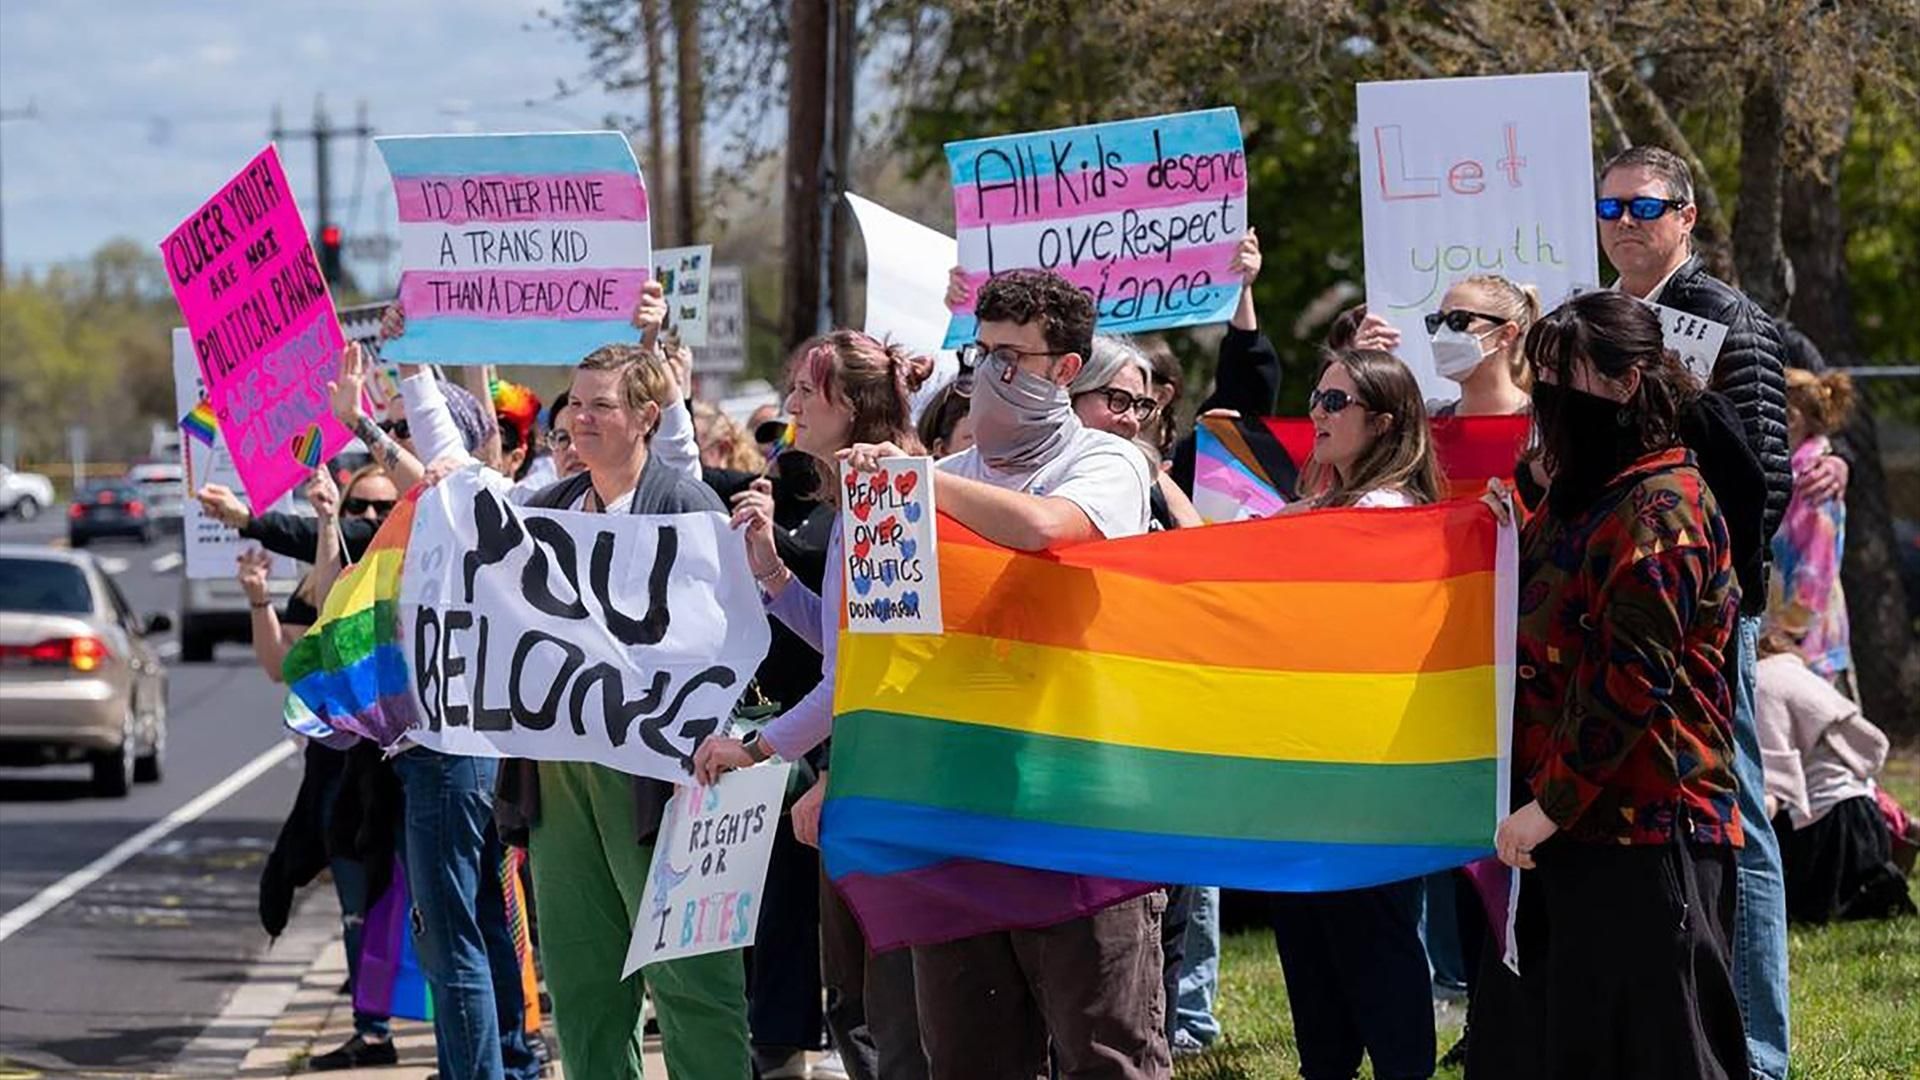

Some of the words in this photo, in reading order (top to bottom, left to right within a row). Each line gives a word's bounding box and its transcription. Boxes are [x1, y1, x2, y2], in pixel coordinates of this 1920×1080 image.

[974, 143, 1041, 220] All
[1051, 133, 1129, 208] Kids
[1147, 129, 1243, 192] deserve
[1374, 122, 1528, 201] Let
[169, 206, 237, 287] QUEER
[225, 159, 281, 235] YOUTH
[420, 182, 454, 218] I'D
[462, 179, 541, 217] RATHER
[550, 180, 605, 213] HAVE
[208, 264, 239, 300] ARE
[245, 227, 279, 267] NOT
[440, 232, 457, 266] A
[463, 229, 544, 265] TRANS
[551, 230, 589, 263] KID
[1387, 222, 1566, 309] youth
[428, 279, 485, 313] THAN
[487, 278, 501, 311] A
[505, 279, 564, 314] DEAD
[566, 278, 620, 314] ONE.
[197, 288, 281, 387] POLITICAL
[1673, 315, 1708, 340] SEE
[847, 482, 912, 511] PEOPLE
[854, 523, 904, 547] OVER
[463, 488, 679, 646] YOU
[849, 554, 923, 582] POLITICS
[414, 604, 736, 775] BELONG
[689, 804, 767, 854] RIGHTS
[700, 849, 726, 877] OR
